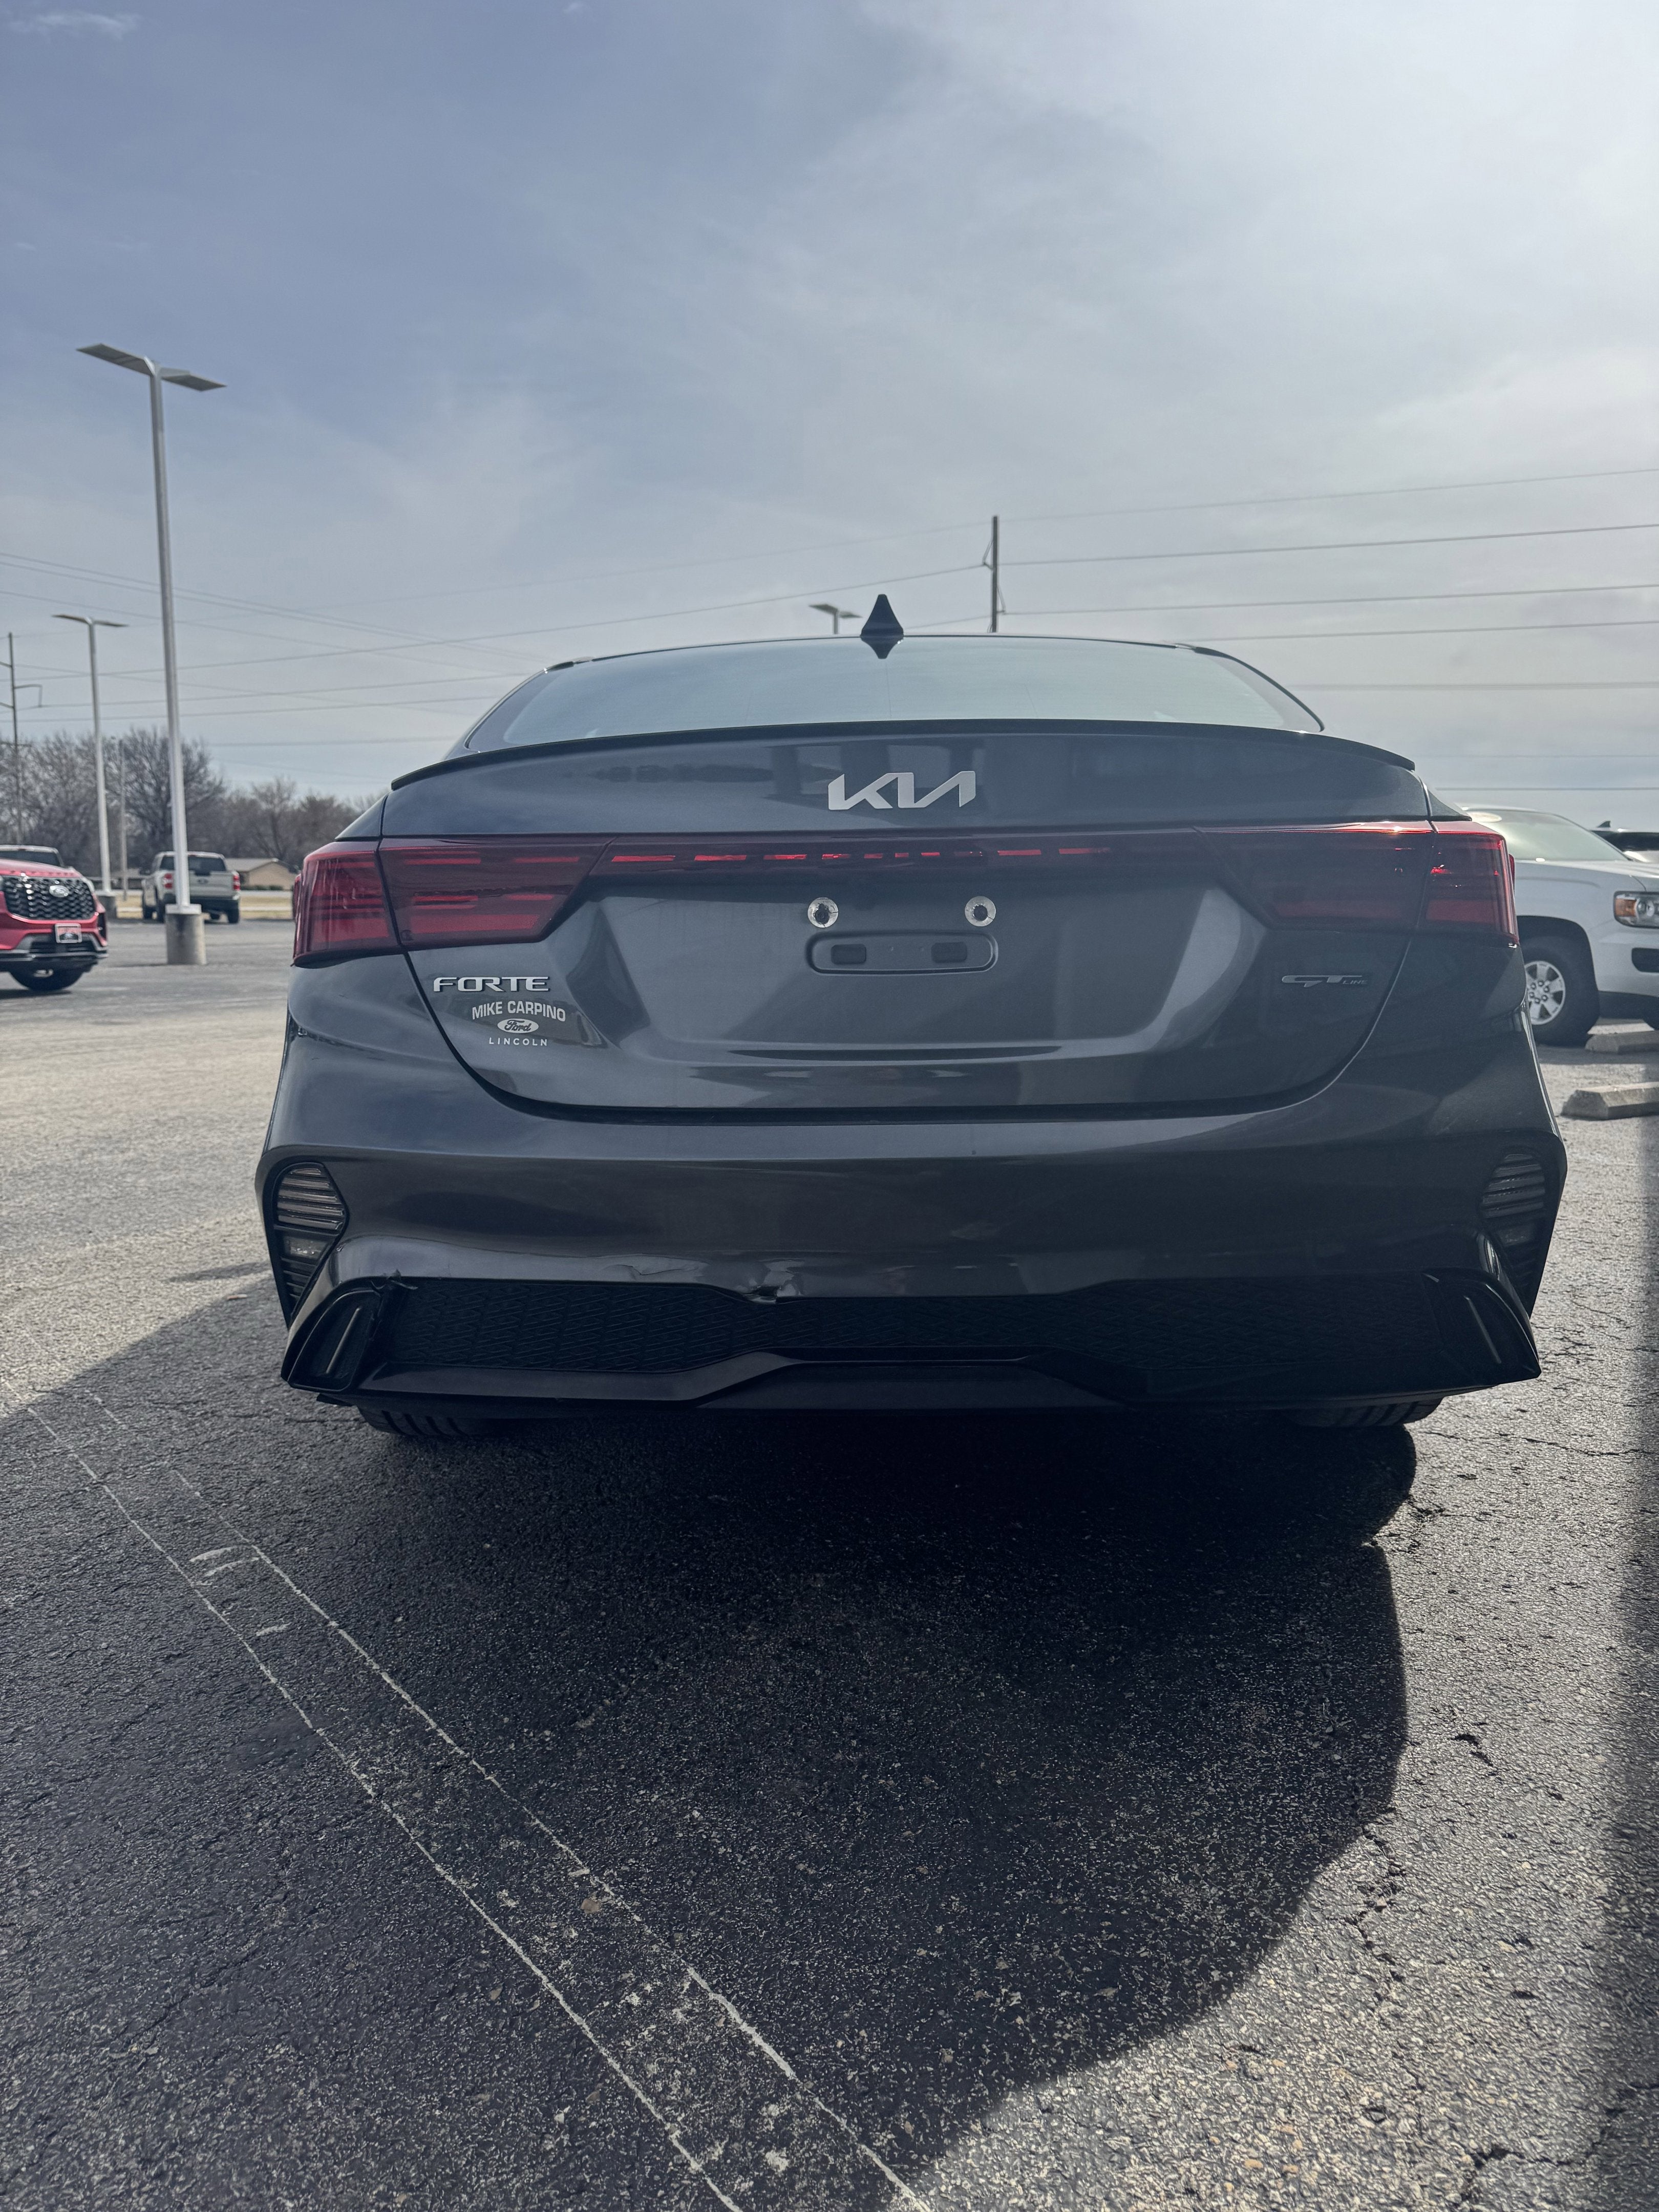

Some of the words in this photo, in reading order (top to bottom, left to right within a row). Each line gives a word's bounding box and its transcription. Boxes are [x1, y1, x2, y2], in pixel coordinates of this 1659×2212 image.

[828, 771, 976, 810] KIA
[434, 976, 549, 992] FORTE
[1282, 975, 1363, 988] GT
[472, 1002, 502, 1019] MIKE
[507, 1001, 566, 1022] CARPINO
[504, 1019, 531, 1031] Ford
[489, 1037, 547, 1046] LINCOLN
